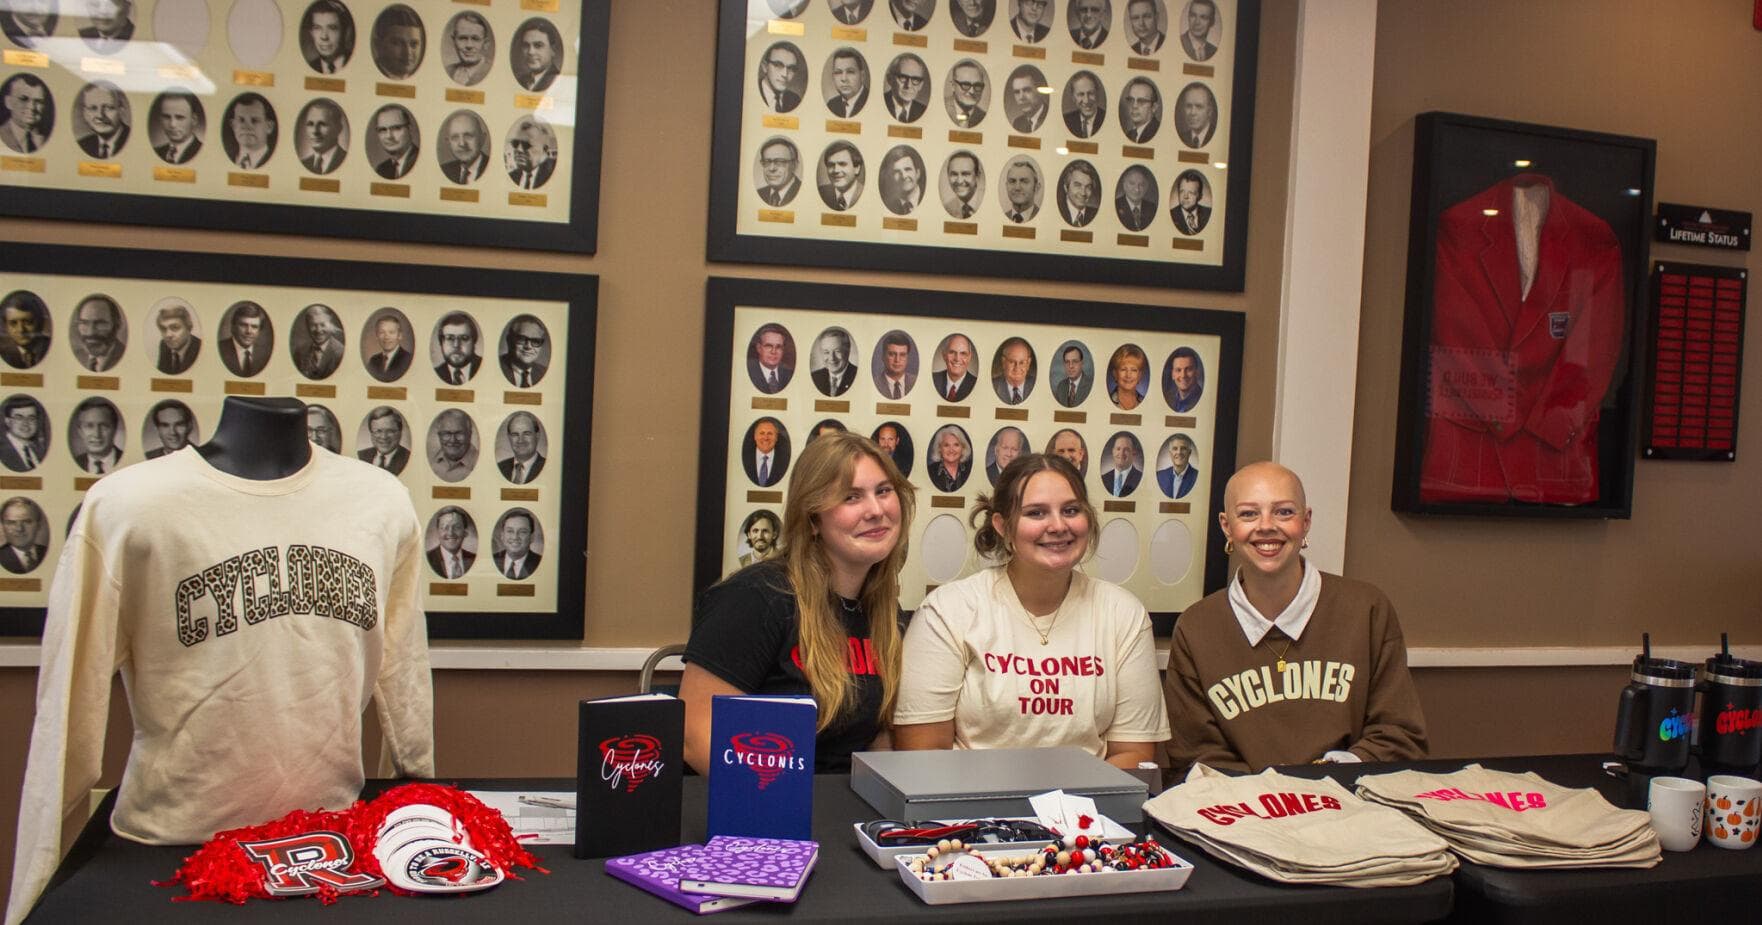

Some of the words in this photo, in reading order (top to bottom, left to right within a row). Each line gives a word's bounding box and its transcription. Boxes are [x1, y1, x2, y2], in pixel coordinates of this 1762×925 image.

[1670, 228, 1706, 243] LIFETIME
[1708, 232, 1739, 247] STATUS
[175, 544, 378, 648] CYCLONES
[984, 653, 1105, 677] CYCLONES
[1029, 678, 1060, 695] ON
[1207, 660, 1356, 721] CYCLONES
[1018, 697, 1074, 716] TOUR
[601, 748, 665, 790] Cyclones
[723, 748, 806, 771] CYCLONES
[270, 858, 349, 877] Cyclones
